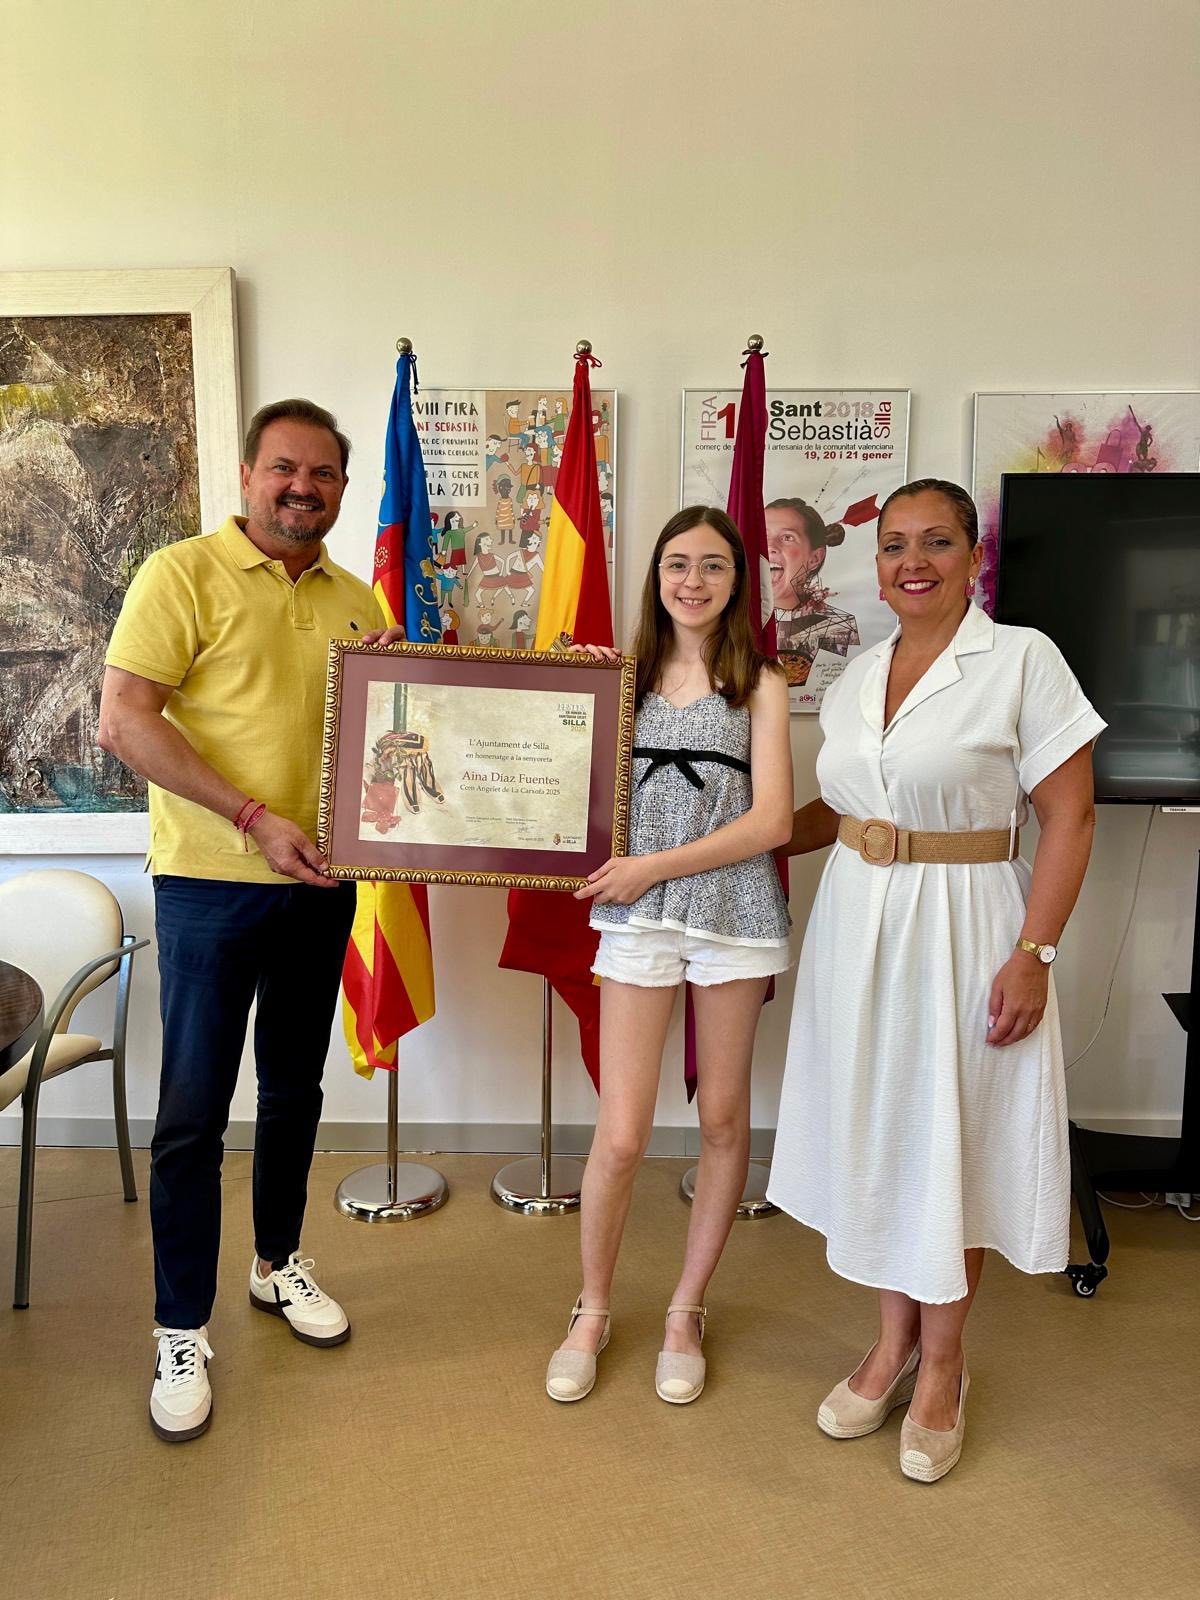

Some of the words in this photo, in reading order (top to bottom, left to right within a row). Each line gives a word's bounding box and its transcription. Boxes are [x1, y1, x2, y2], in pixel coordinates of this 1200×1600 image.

[445, 402, 478, 416] FIRA
[770, 400, 822, 417] Sant
[824, 401, 874, 418] 2018
[701, 396, 717, 440] FIRA
[873, 401, 892, 439] Silla
[416, 421, 430, 432] NT
[769, 418, 873, 440] Sebastià
[804, 451, 820, 460] 19,
[823, 451, 836, 459] 20
[840, 451, 843, 459] i
[846, 451, 858, 459] 21
[862, 452, 892, 460] gener
[452, 470, 479, 479] GENER
[427, 482, 446, 496] LA
[451, 483, 479, 497] 2017
[522, 742, 531, 750] de
[533, 742, 549, 750] Silla
[475, 753, 509, 761] homenatge
[462, 771, 487, 781] Aina
[519, 773, 560, 785] Fuentes
